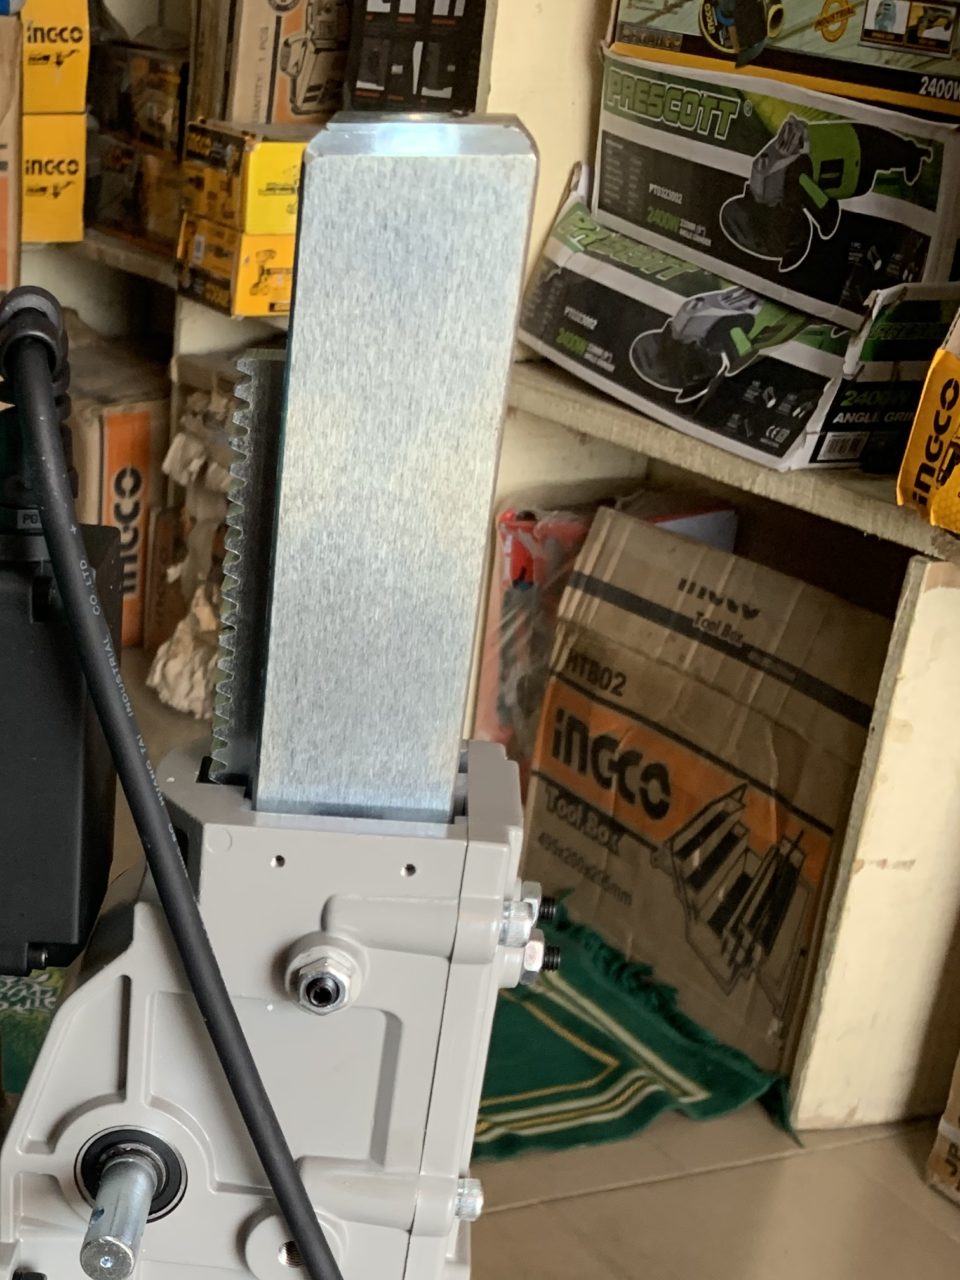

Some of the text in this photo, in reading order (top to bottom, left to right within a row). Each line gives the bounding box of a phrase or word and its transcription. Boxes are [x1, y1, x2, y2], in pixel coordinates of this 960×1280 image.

[606, 66, 741, 140] PRESCOTT
[25, 159, 80, 176] INGCO
[551, 707, 673, 822] INGCO
